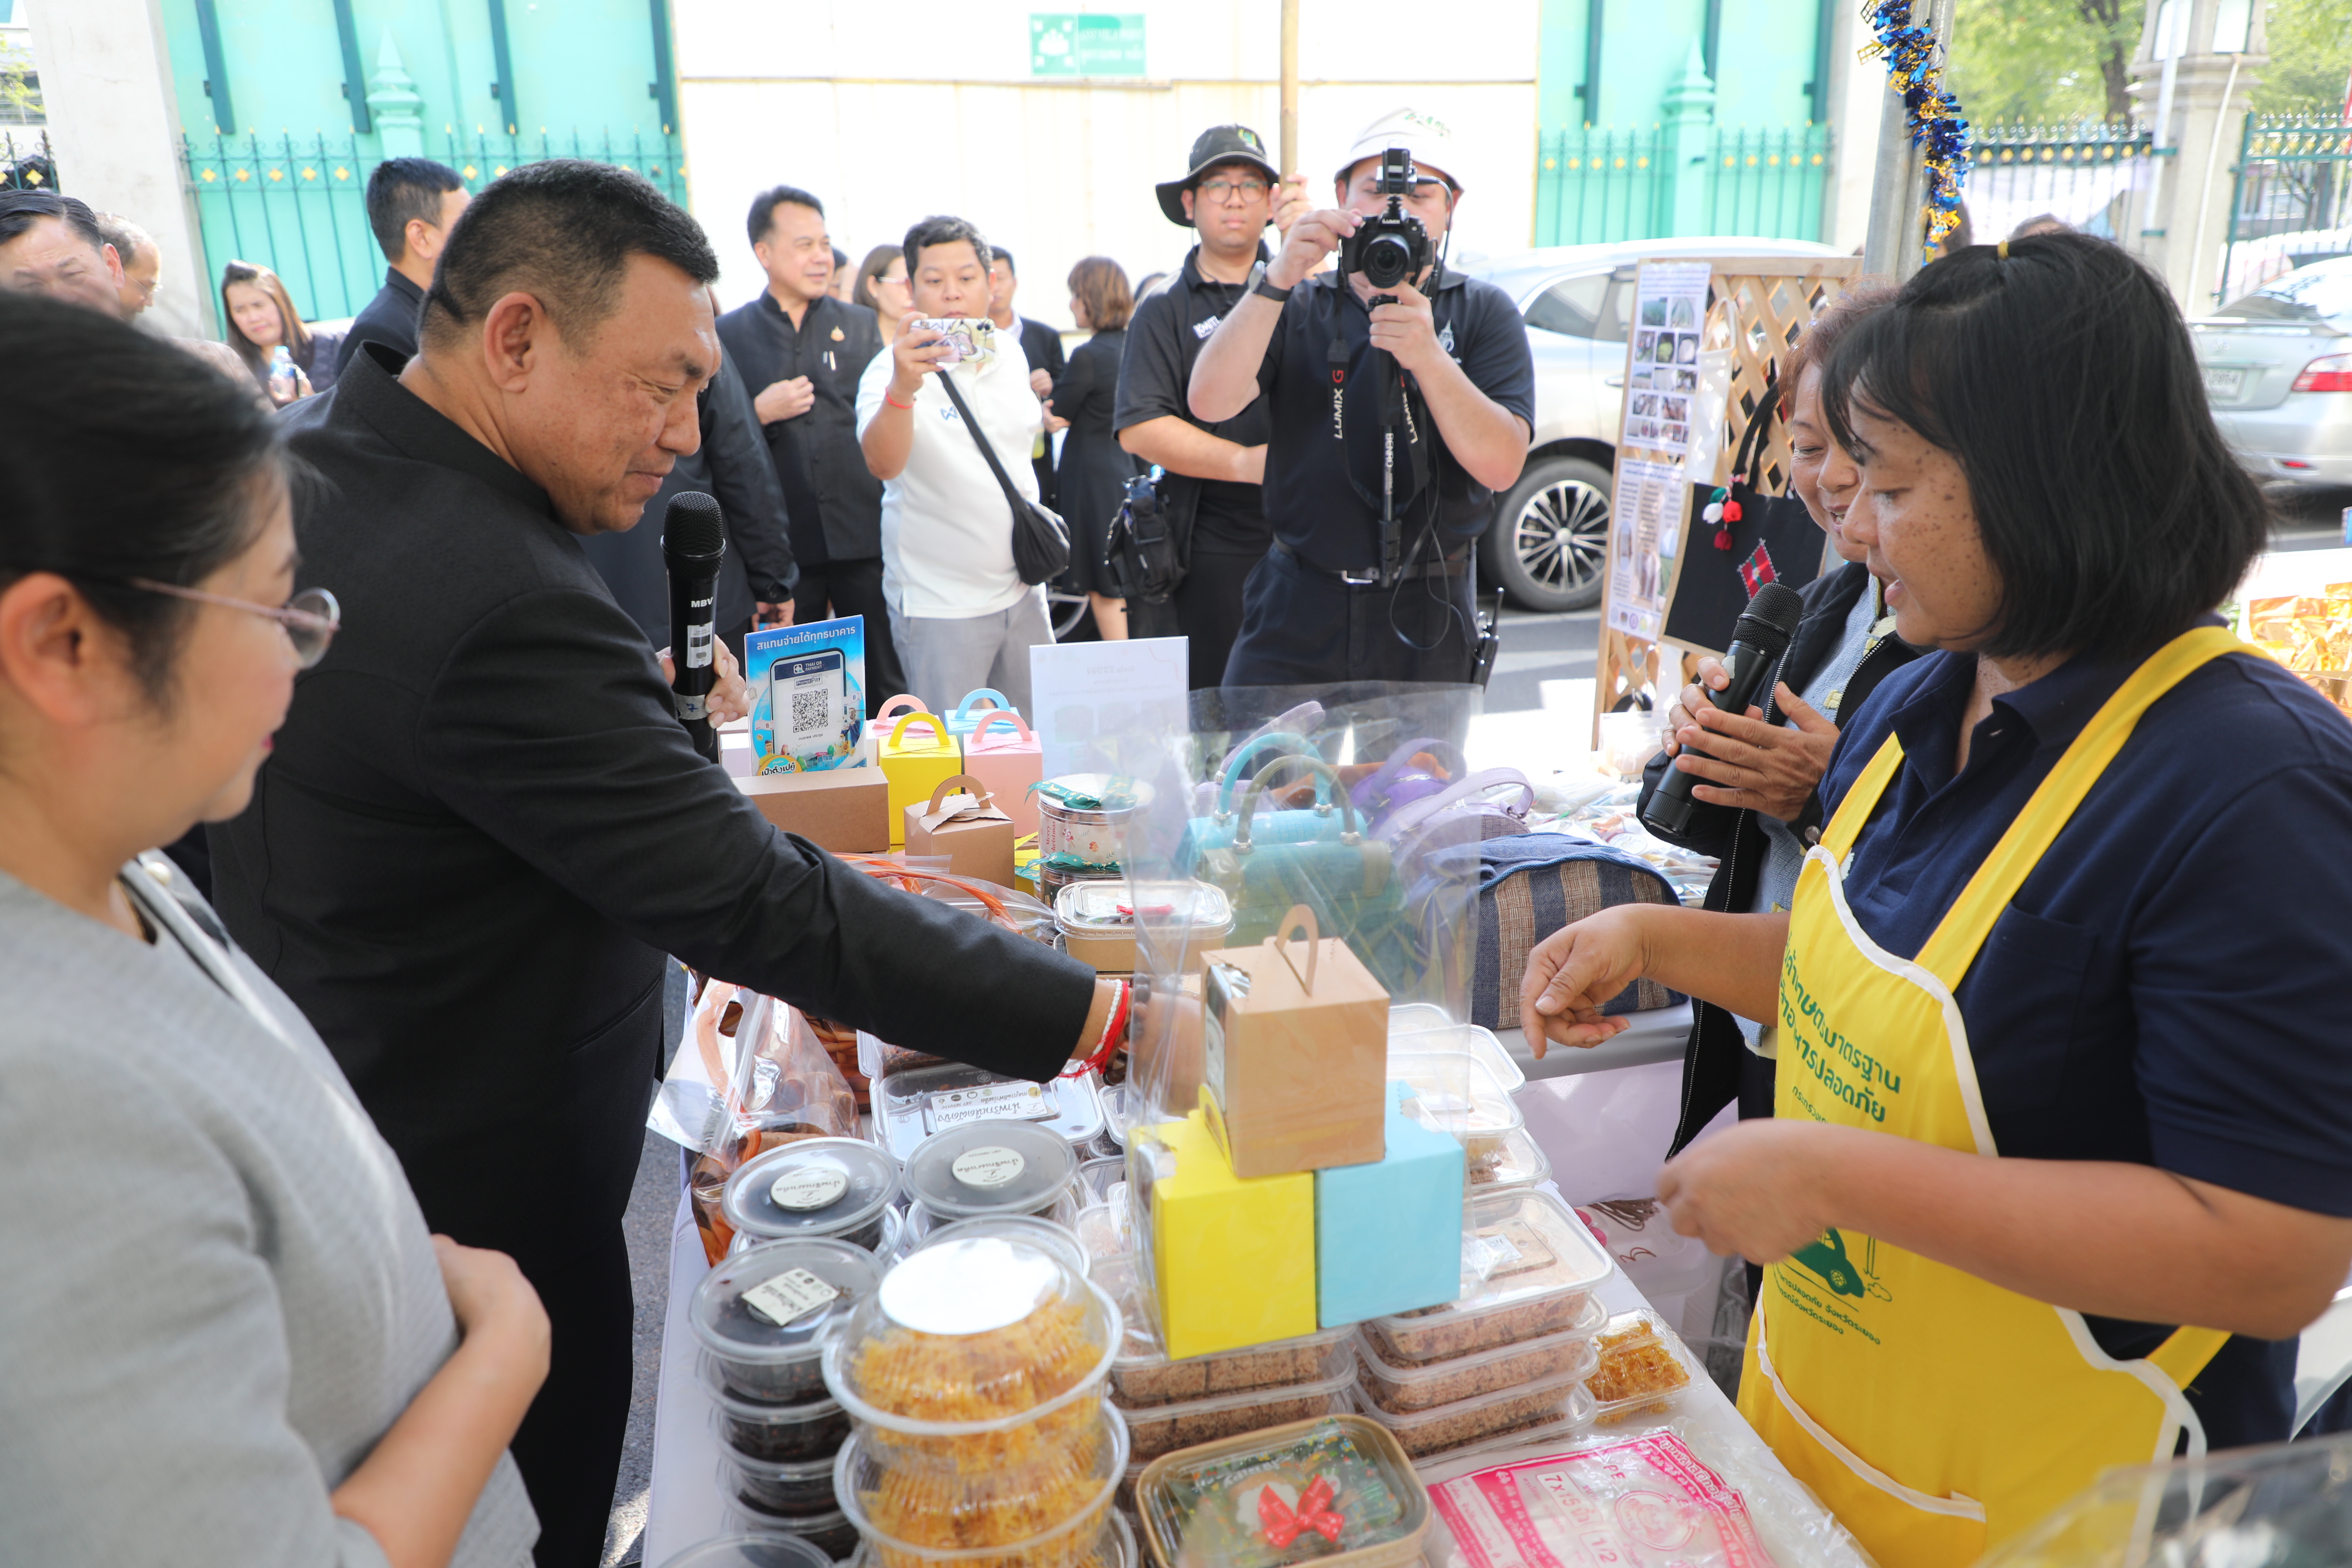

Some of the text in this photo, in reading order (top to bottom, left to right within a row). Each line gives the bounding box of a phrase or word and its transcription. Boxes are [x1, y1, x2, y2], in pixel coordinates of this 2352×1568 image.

[1332, 370, 1344, 439] LUMIX G
[1385, 433, 1394, 468] BENRO
[691, 596, 713, 607] MBV
[757, 626, 856, 650] สแกนจ่ายได้ทุกธนาคาร
[938, 1102, 1021, 1122] น้ำพริกเห็ดผัดขิง
[1826, 1305, 1880, 1345] จังหวัดระยอง
[1603, 1465, 1626, 1480] PE
